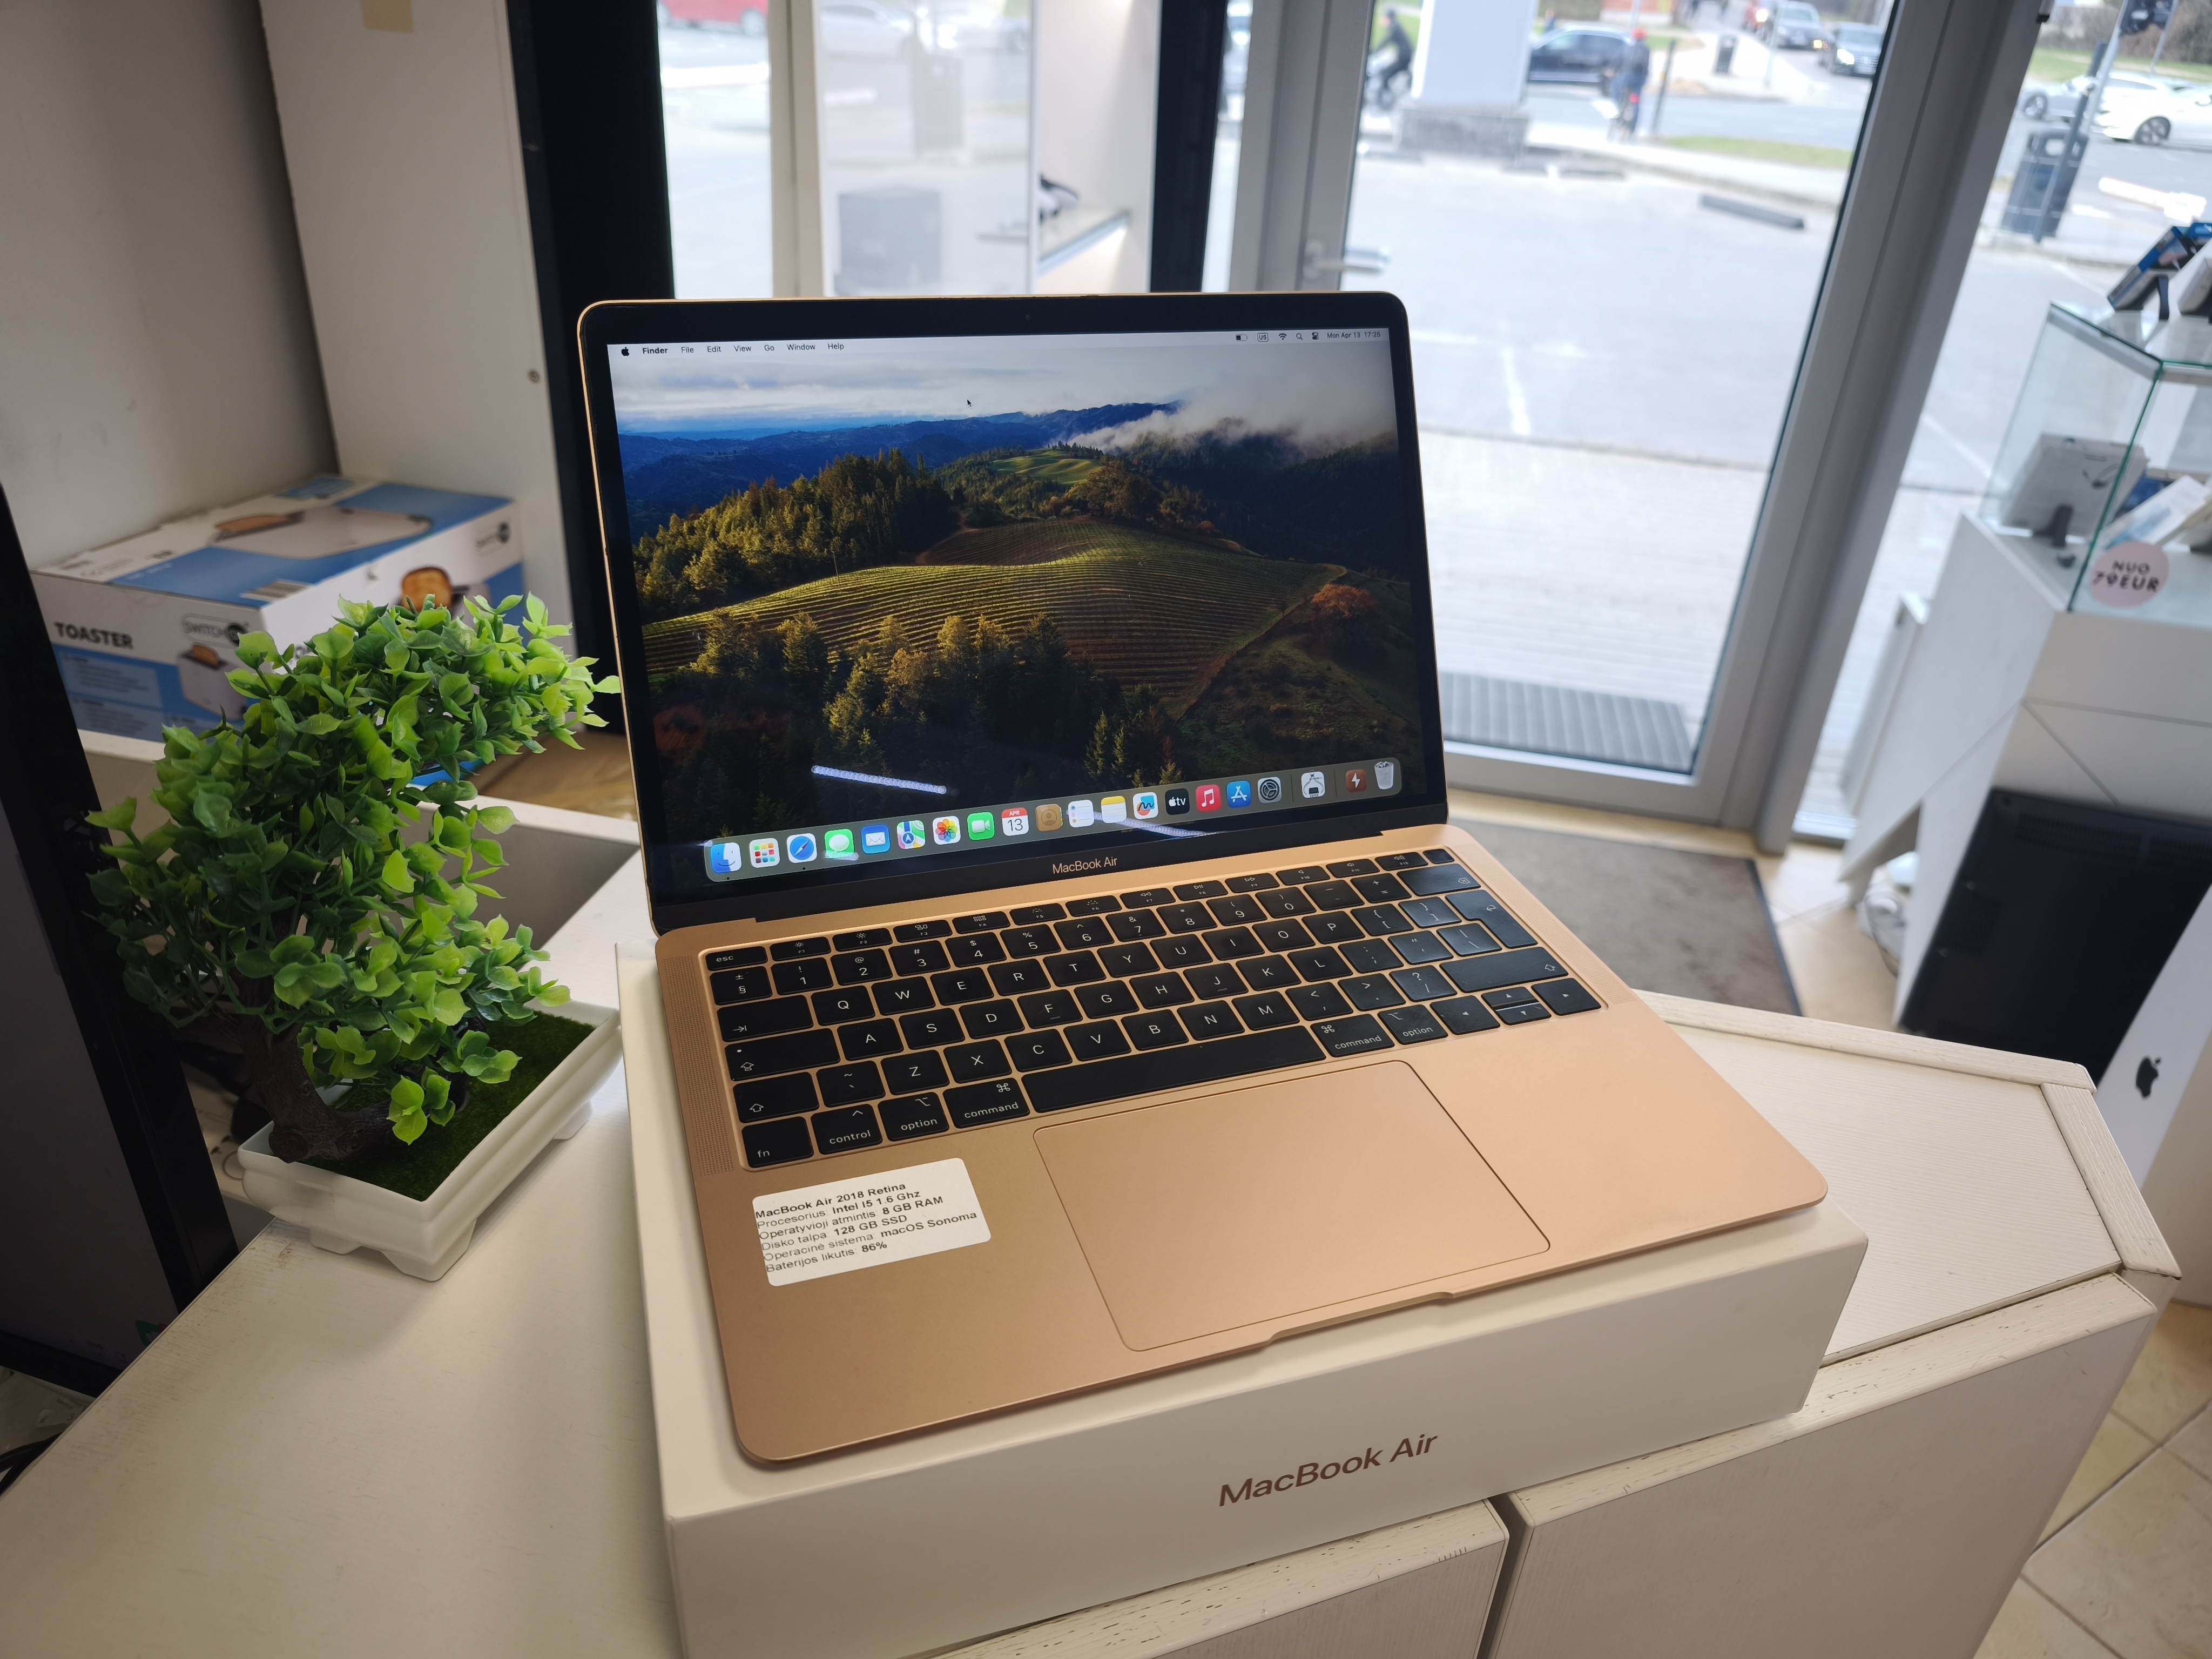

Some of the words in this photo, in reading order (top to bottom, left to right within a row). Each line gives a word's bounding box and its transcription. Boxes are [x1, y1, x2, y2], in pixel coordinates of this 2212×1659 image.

[2112, 559, 2150, 575] NUO
[54, 622, 133, 650] TOASTER
[1008, 819, 1023, 831] 13
[1053, 858, 1102, 874] MacBook
[1103, 856, 1117, 867] Air
[1327, 923, 1336, 931] P
[1278, 930, 1289, 939] O
[1175, 946, 1186, 955] U
[917, 959, 927, 967] 3
[1122, 955, 1131, 963] Y
[1314, 960, 1326, 968] L
[859, 967, 868, 976] 2
[1068, 963, 1077, 972] T
[1262, 967, 1274, 976] K
[1013, 973, 1024, 981] R
[1214, 976, 1220, 985] J
[956, 981, 967, 990] E
[1155, 985, 1168, 994] H
[894, 990, 909, 1000] W
[1101, 994, 1112, 1003] G
[838, 1000, 849, 1009] Q
[1044, 1004, 1053, 1013] F
[1258, 1005, 1273, 1015] M
[985, 1014, 997, 1023] D
[1204, 1015, 1218, 1024] N
[926, 1023, 937, 1033] S
[1148, 1025, 1161, 1034] B
[1402, 1027, 1433, 1037] option
[866, 1034, 876, 1043] A
[1090, 1034, 1101, 1044] V
[1334, 1035, 1382, 1049] command
[1033, 1045, 1044, 1055] C
[970, 1055, 984, 1065] X
[909, 1066, 921, 1077] Z
[964, 1101, 1019, 1118] command
[901, 1119, 938, 1131] option
[829, 1130, 871, 1144] control
[757, 1150, 770, 1158] fn
[756, 1202, 812, 1218] MacBook
[815, 1198, 832, 1206] Air
[837, 1191, 864, 1202] 2018
[868, 1184, 905, 1196] Retina
[832, 1202, 858, 1214] Intel
[876, 1196, 893, 1205] 1.6
[896, 1191, 921, 1200] Ghz
[759, 1220, 828, 1239] Operatyvioji
[893, 1203, 912, 1212] GB
[915, 1196, 943, 1208] RAM
[881, 1223, 923, 1237] macOS
[927, 1213, 977, 1227] Sonoma
[761, 1239, 794, 1251] Disko
[834, 1226, 855, 1236] 128
[859, 1220, 878, 1230] GB
[881, 1215, 907, 1226] SSD
[766, 1257, 818, 1272] Baterijos
[862, 1242, 887, 1252] 86%
[1219, 1447, 1384, 1507] MacBook
[1389, 1434, 1438, 1463] Air
